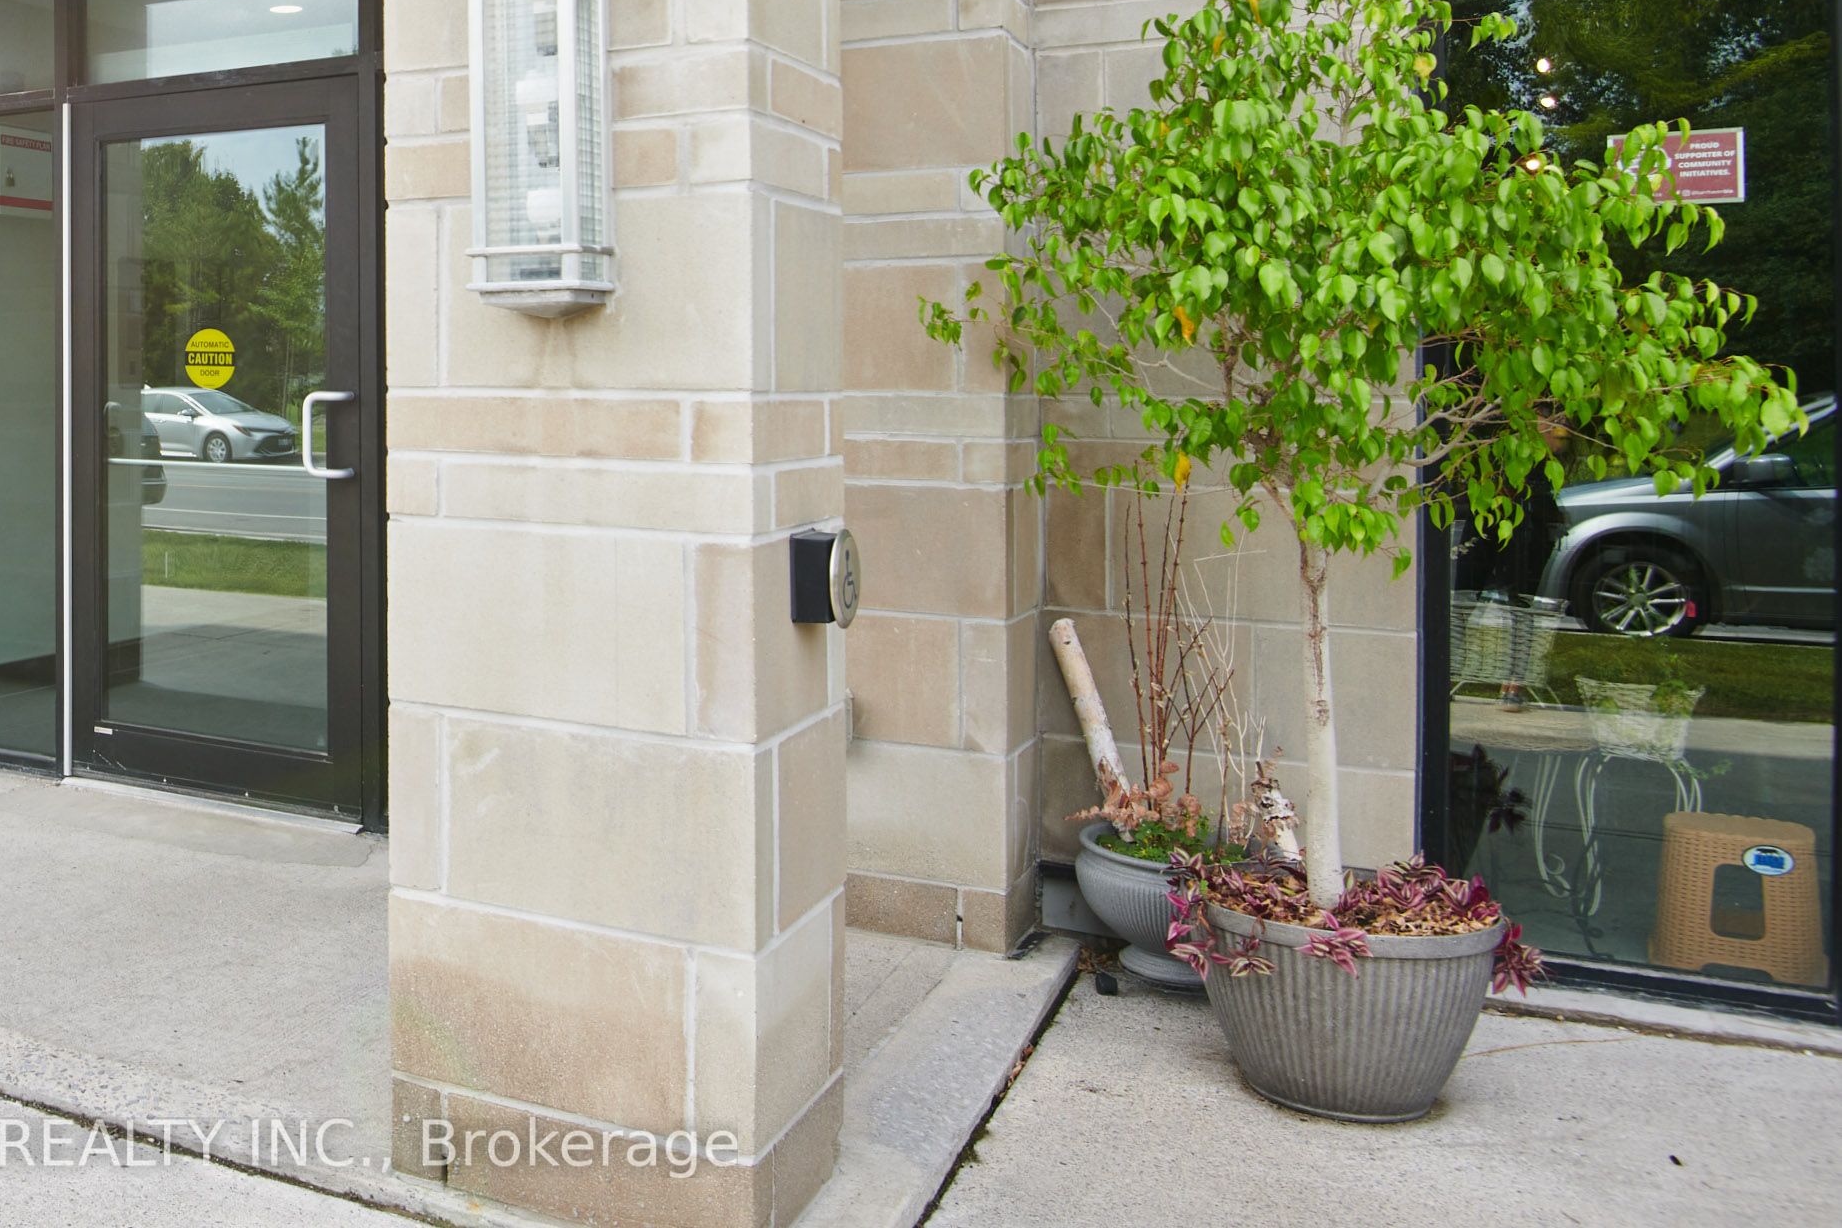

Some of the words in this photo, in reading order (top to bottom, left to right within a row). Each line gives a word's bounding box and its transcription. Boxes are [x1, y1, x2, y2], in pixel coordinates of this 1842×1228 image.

[1690, 141, 1720, 149] PROUD
[1674, 151, 1722, 160] SUPPORTER
[1678, 159, 1732, 168] COMMUNITY
[188, 353, 233, 365] CAUTION
[200, 369, 220, 377] DOOR
